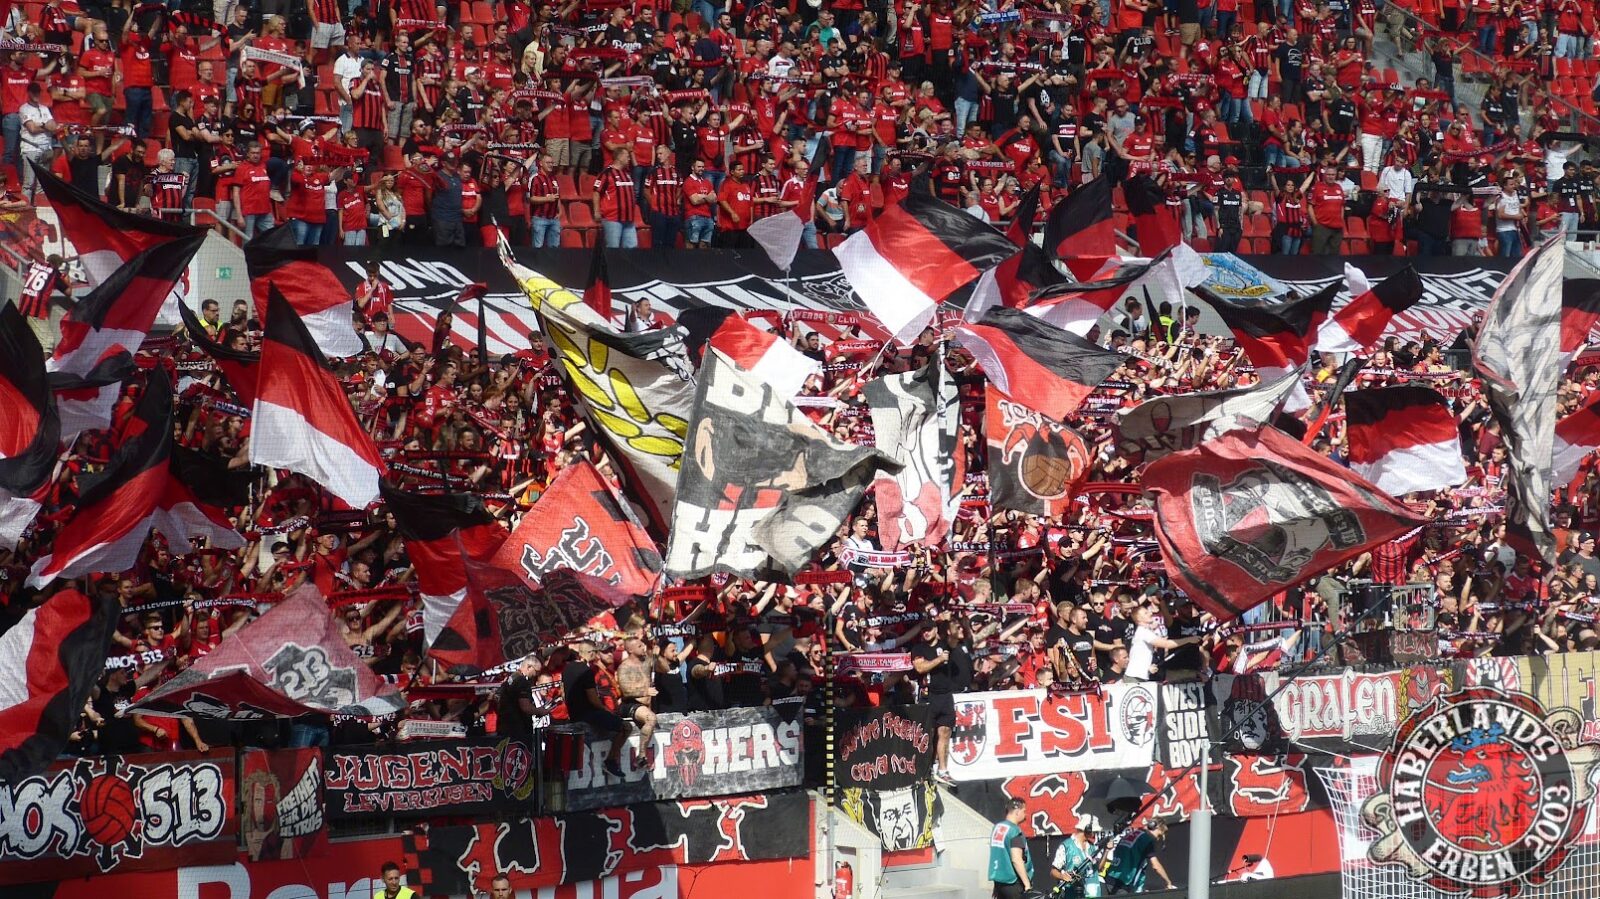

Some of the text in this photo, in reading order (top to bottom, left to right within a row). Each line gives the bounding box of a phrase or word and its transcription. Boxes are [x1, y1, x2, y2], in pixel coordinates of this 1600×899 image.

[23, 268, 48, 291] 76
[140, 648, 164, 665] 513
[1162, 682, 1206, 712] WEST
[992, 689, 1116, 764] FSI
[1165, 710, 1209, 741] SIDE
[325, 746, 501, 790] JUGEND
[1169, 738, 1213, 769] BOY
[276, 756, 321, 817] FREIHEIT
[343, 782, 493, 813] LEVERKUSEN
[140, 763, 226, 847] 513
[279, 807, 300, 827] FÜR
[300, 791, 318, 820] DIE
[280, 809, 323, 837] ULTRAS
